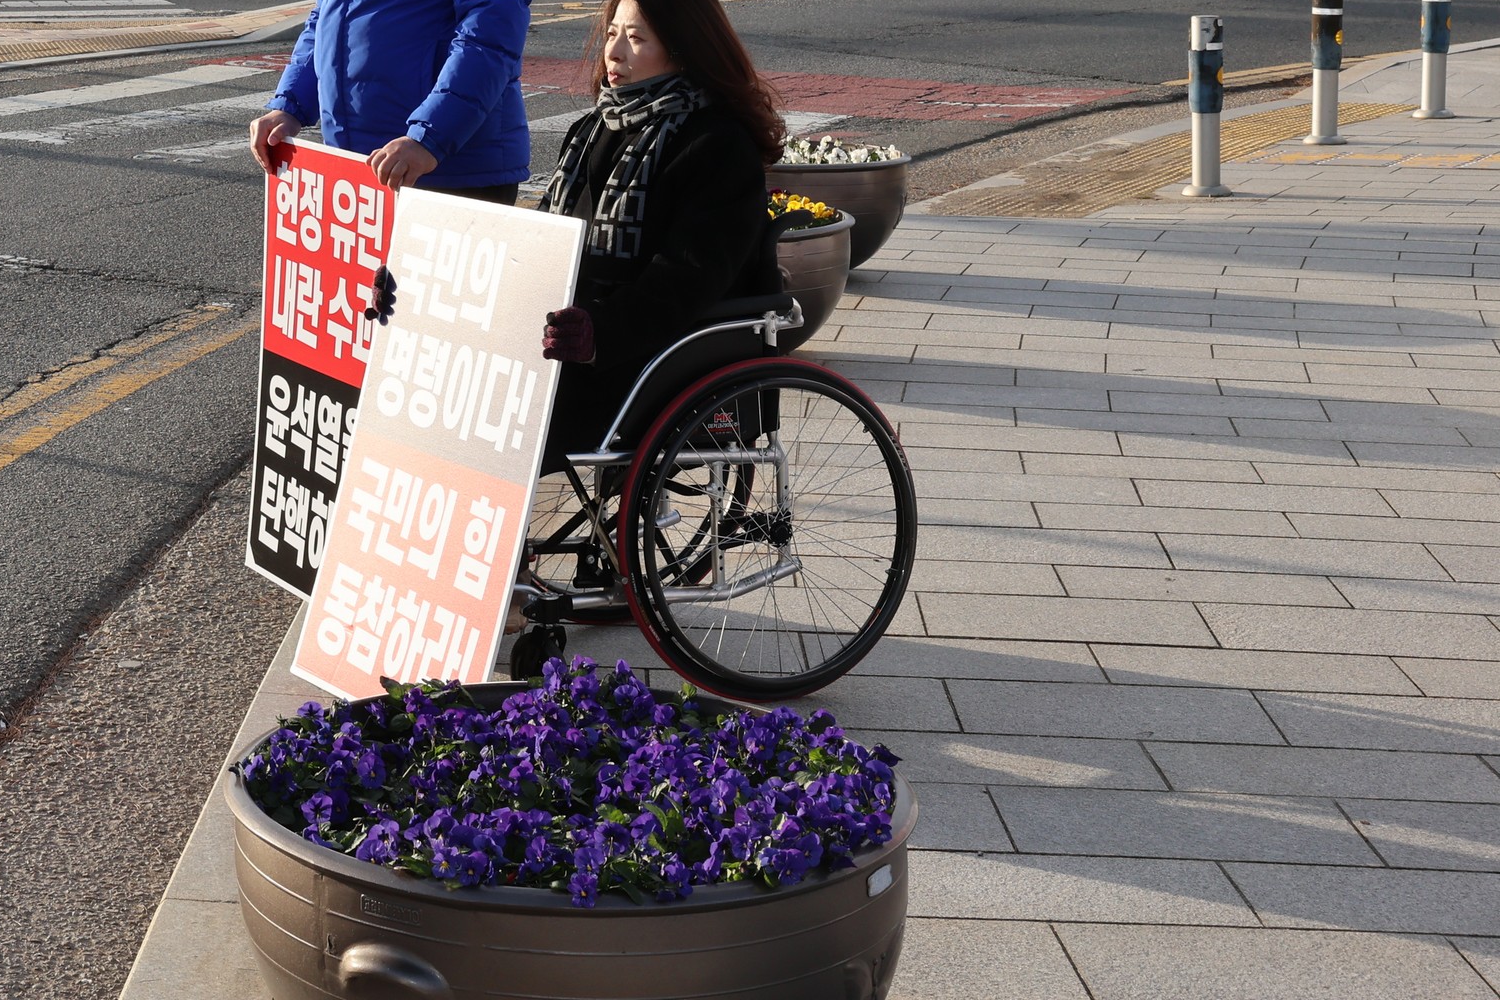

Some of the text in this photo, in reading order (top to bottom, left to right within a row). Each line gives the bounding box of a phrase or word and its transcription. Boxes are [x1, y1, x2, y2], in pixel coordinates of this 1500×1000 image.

[276, 166, 385, 271] 헌정 유린
[399, 221, 507, 333] 국민의
[272, 255, 323, 349] 내란
[376, 323, 538, 453] 명령이다!
[344, 455, 507, 601] 국민의 힘
[317, 560, 482, 684] 동참하라!
